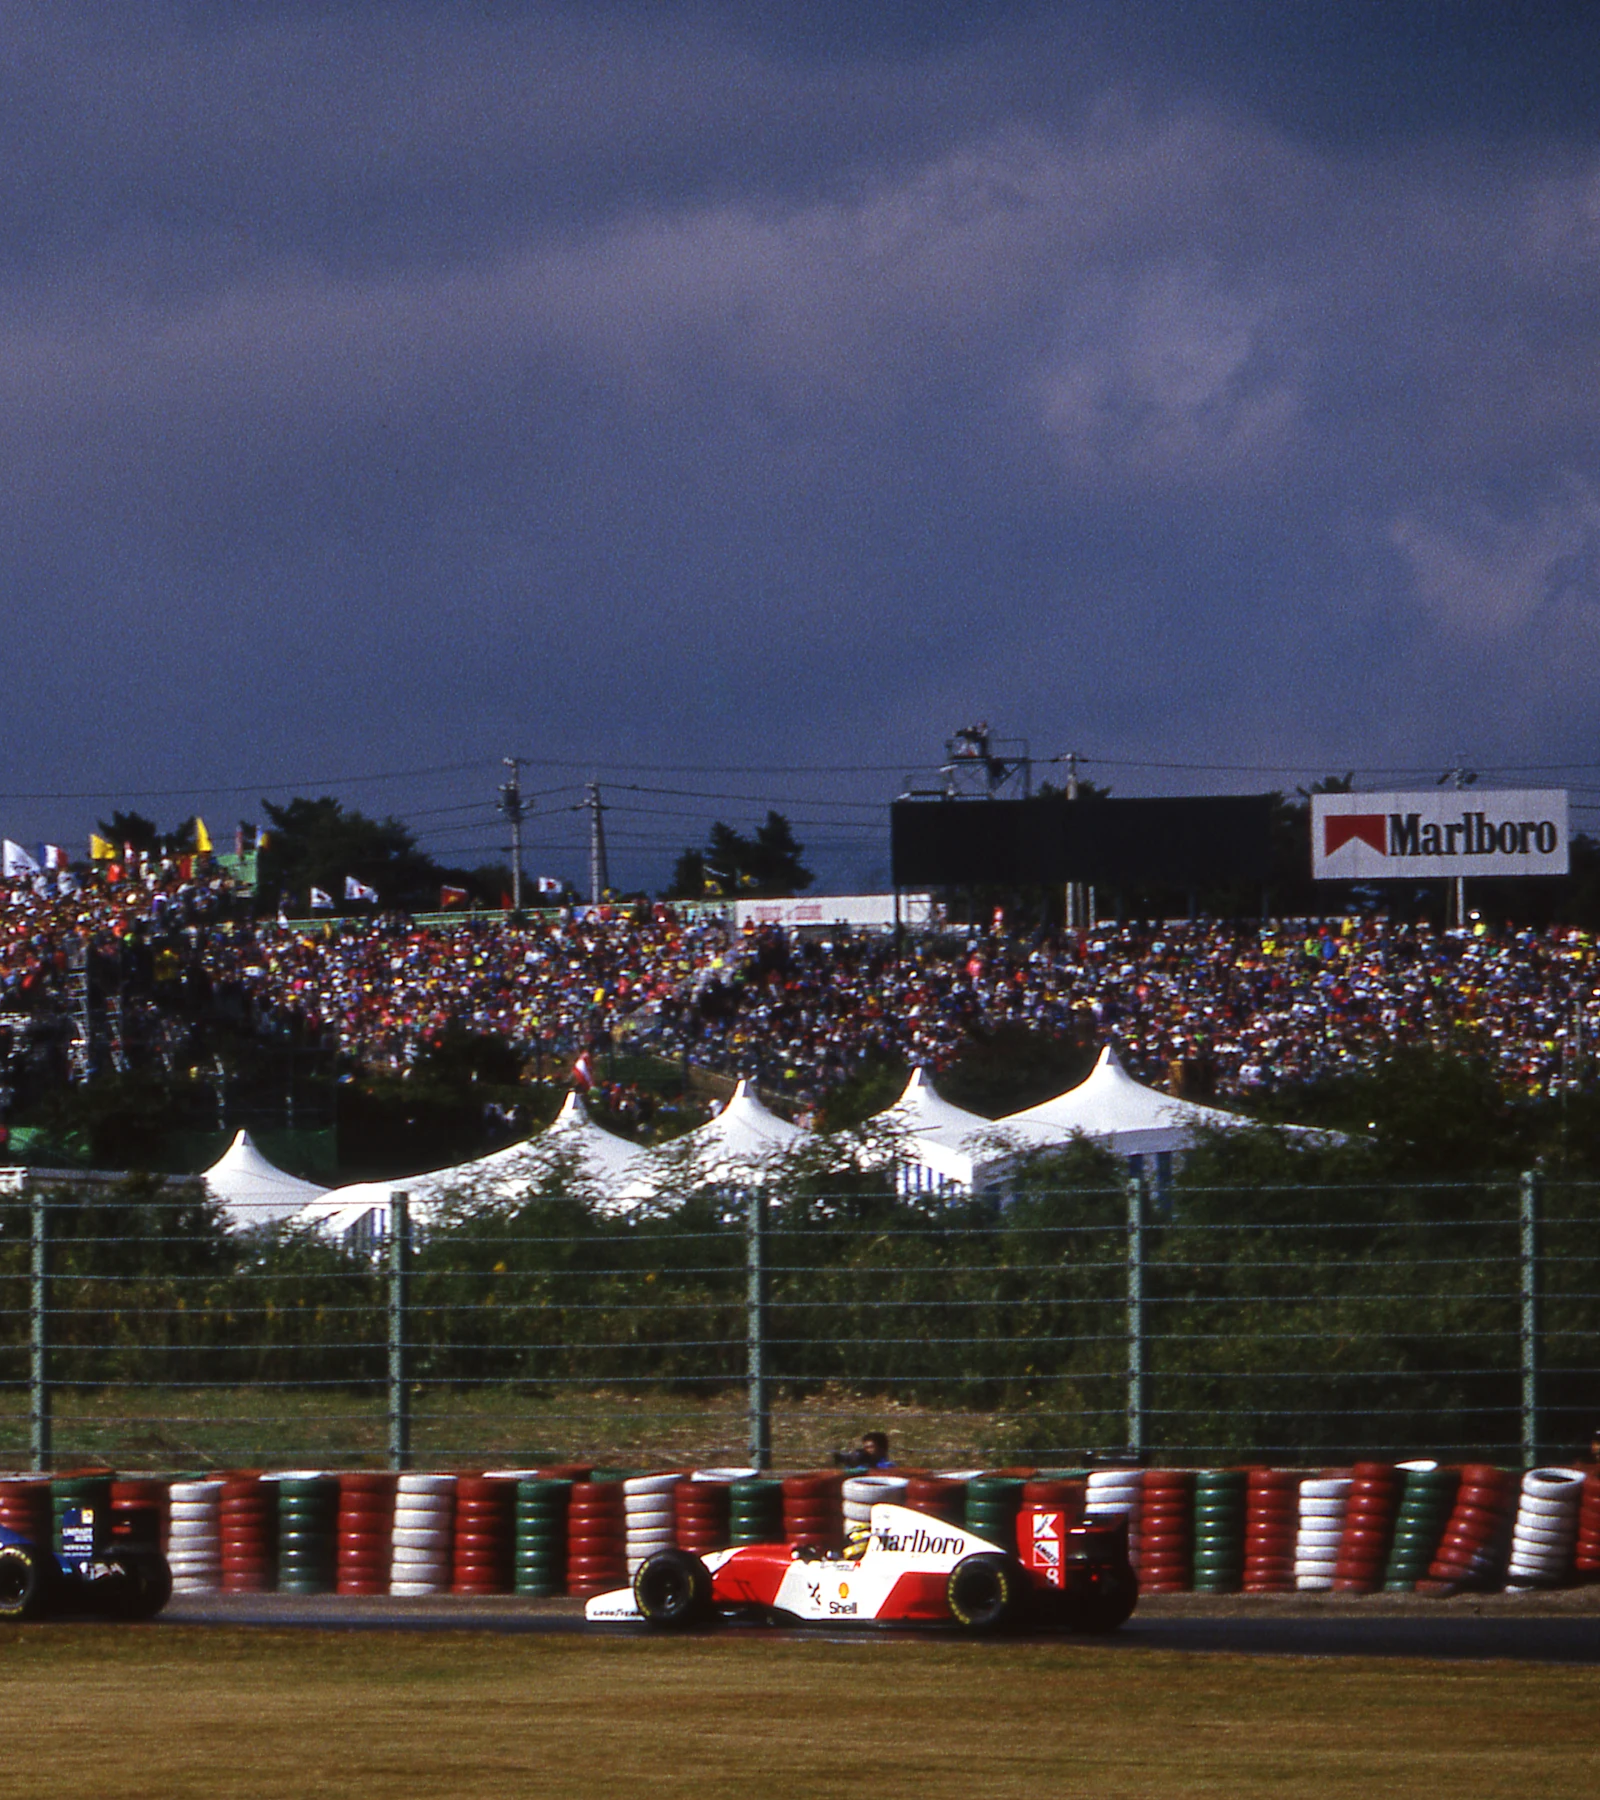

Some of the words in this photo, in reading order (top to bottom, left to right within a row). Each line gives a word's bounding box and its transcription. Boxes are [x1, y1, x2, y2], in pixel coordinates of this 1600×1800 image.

[1390, 812, 1557, 856] Marlboro
[875, 1528, 965, 1555] Marlboro
[829, 1601, 857, 1614] Shell
